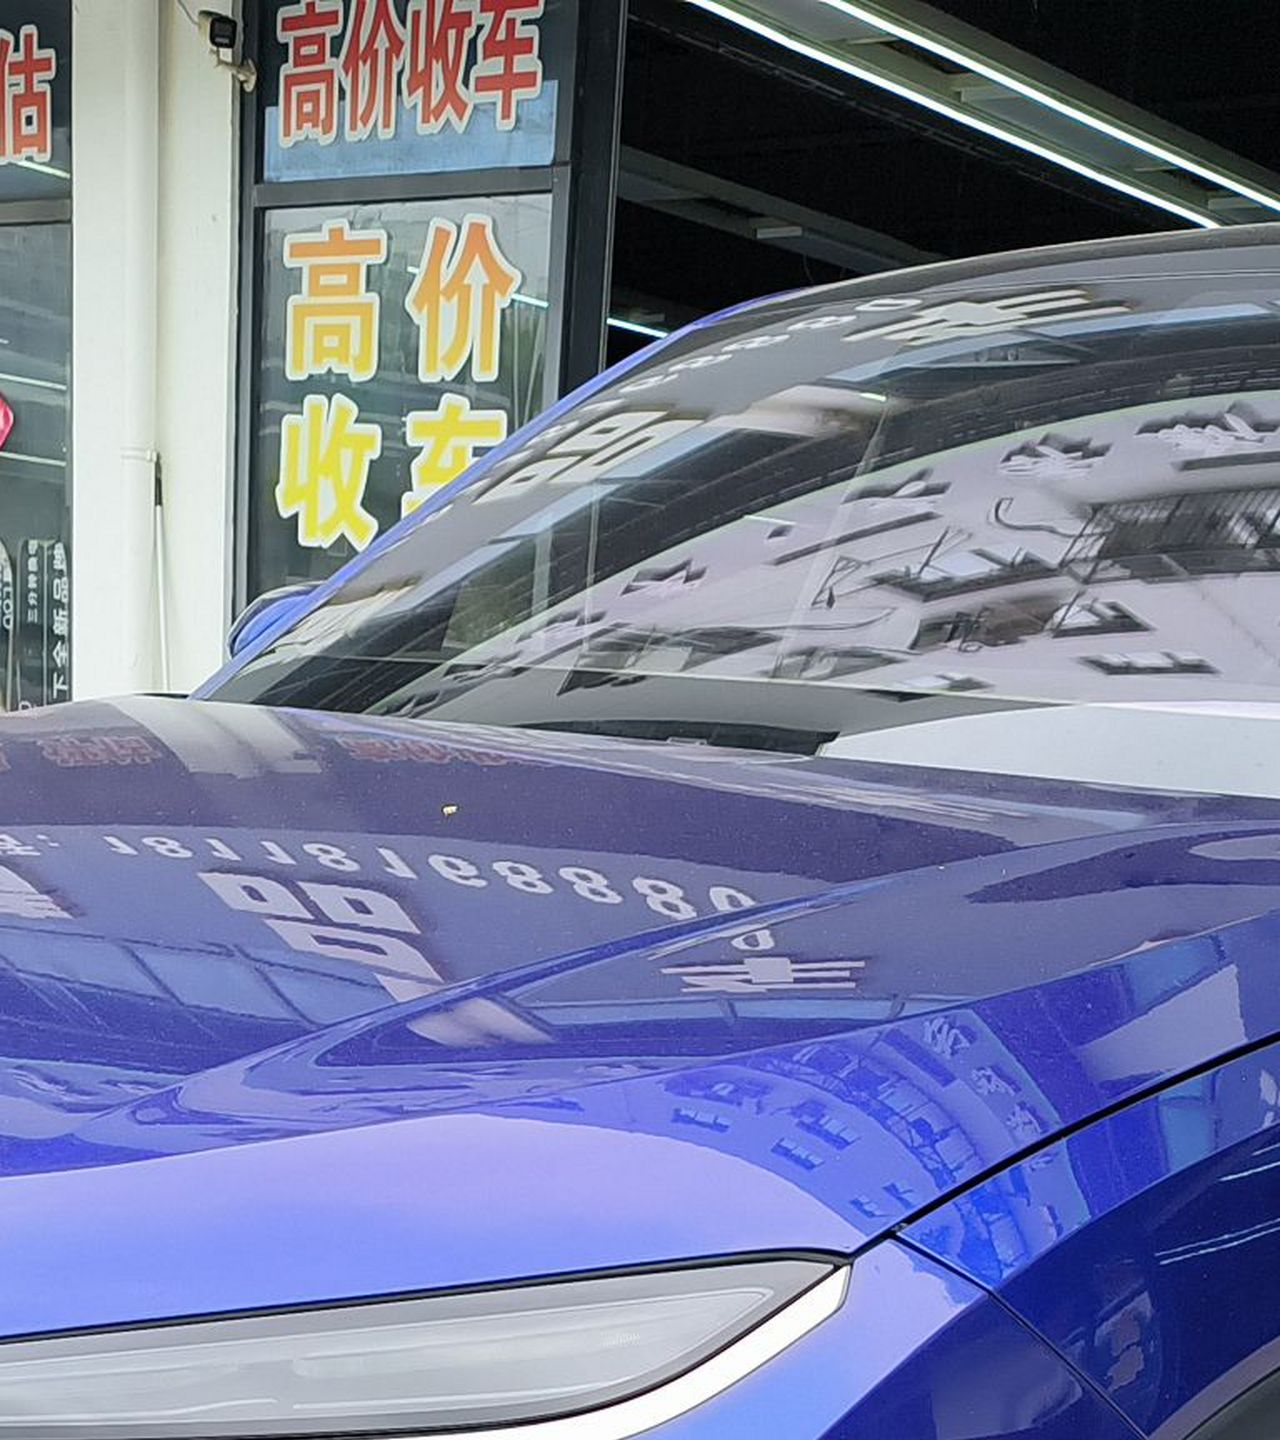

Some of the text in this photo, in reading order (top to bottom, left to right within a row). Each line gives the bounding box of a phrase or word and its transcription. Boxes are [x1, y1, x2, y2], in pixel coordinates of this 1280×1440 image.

[277, 0, 545, 147] 高价收车
[282, 213, 522, 382] 高价
